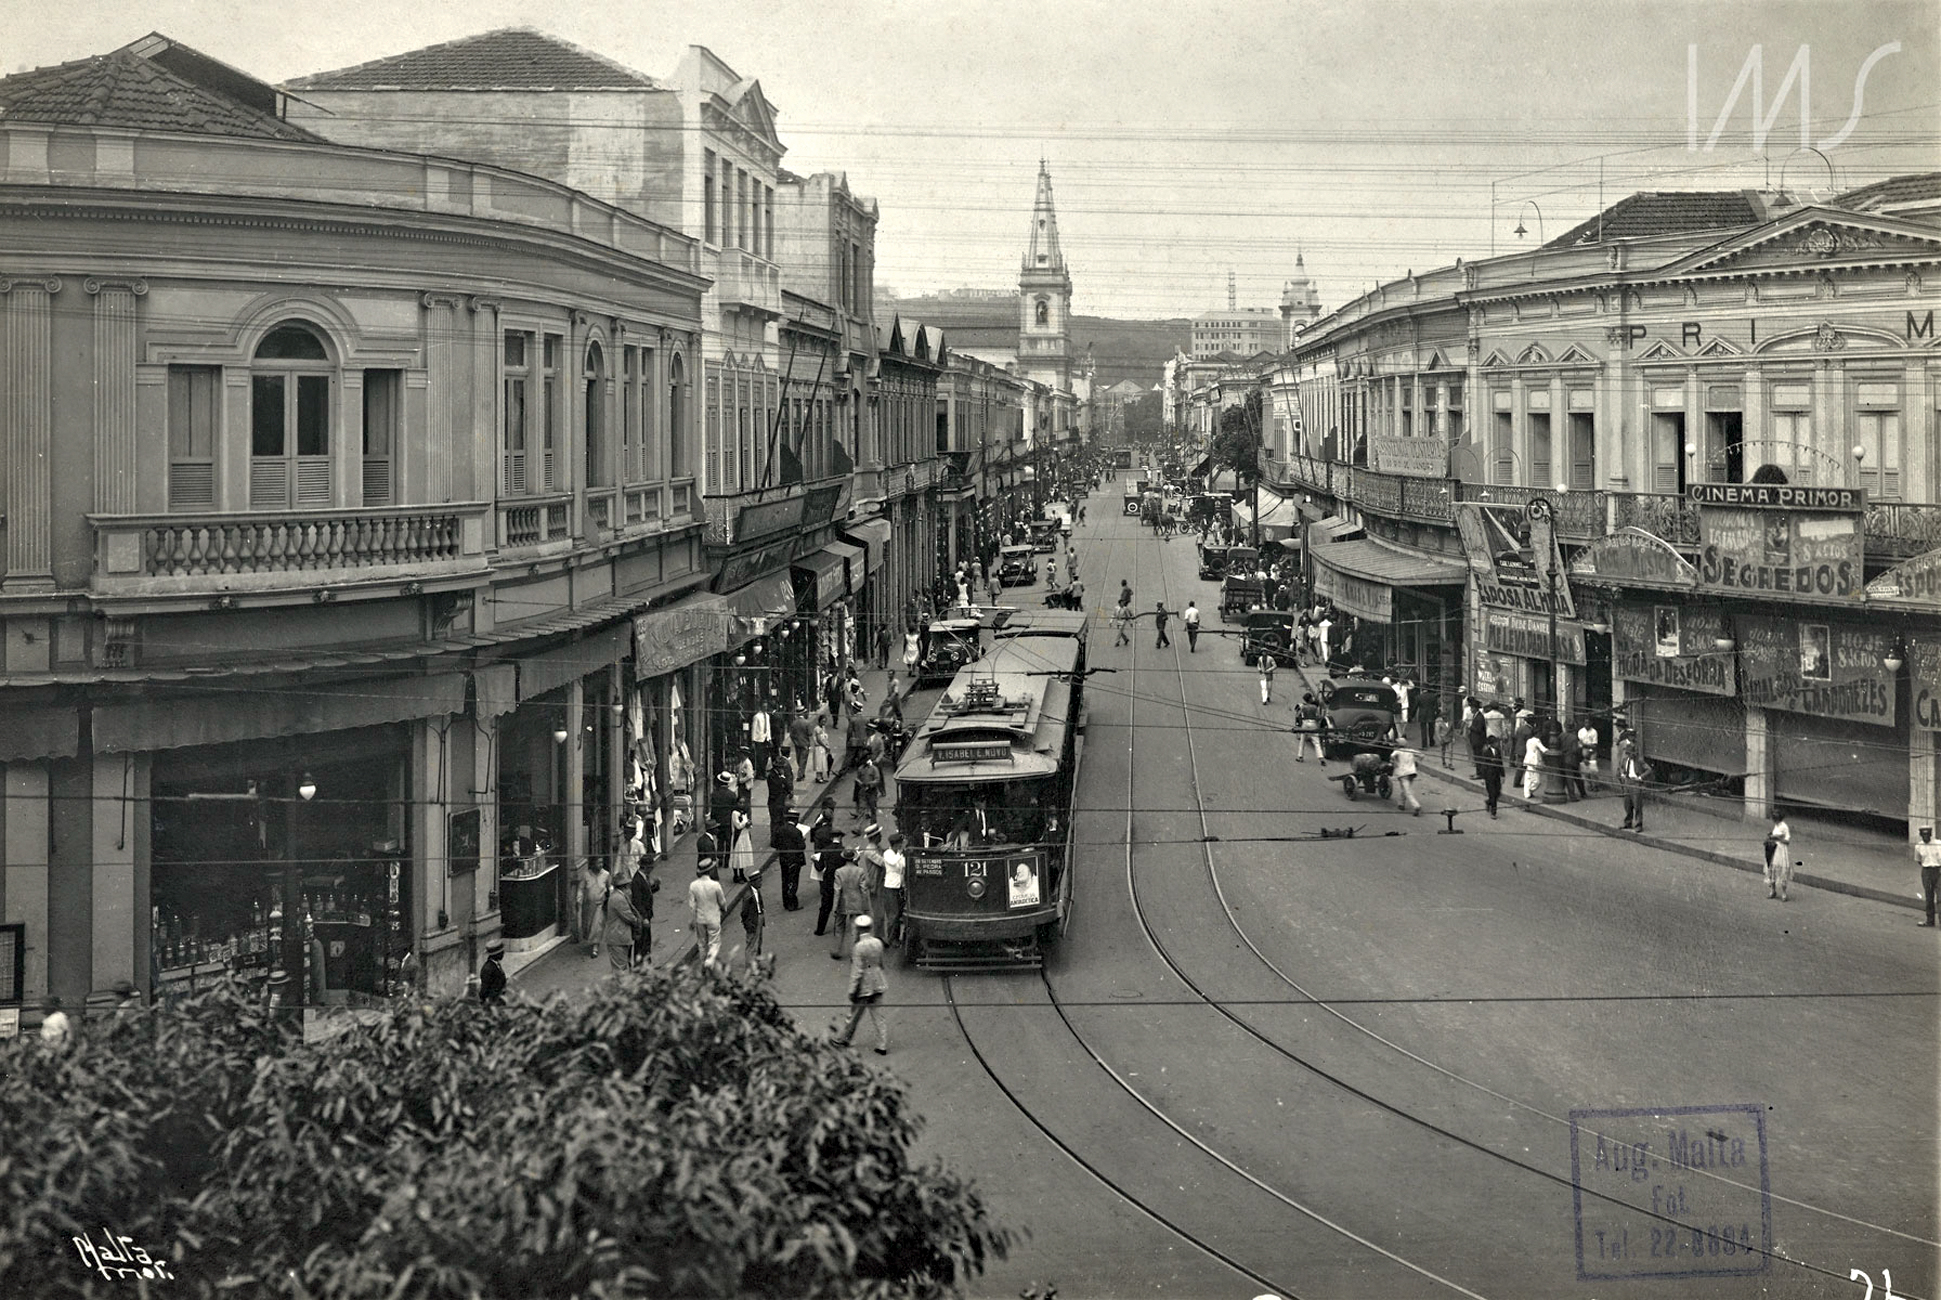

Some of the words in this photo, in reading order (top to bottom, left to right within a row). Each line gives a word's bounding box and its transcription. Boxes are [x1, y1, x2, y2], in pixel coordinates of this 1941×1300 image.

[1691, 485, 1770, 504] CINEMA
[1778, 488, 1853, 508] PRIMOR
[1703, 546, 1852, 597] SEGREDOS
[1475, 574, 1523, 609] ESPOSA
[1841, 632, 1884, 651] HOJE
[1617, 652, 1649, 677] HORA
[1838, 647, 1848, 668] 8
[963, 861, 988, 877] 121
[1594, 1130, 1659, 1182] Aug.
[1668, 1128, 1747, 1170] Malta
